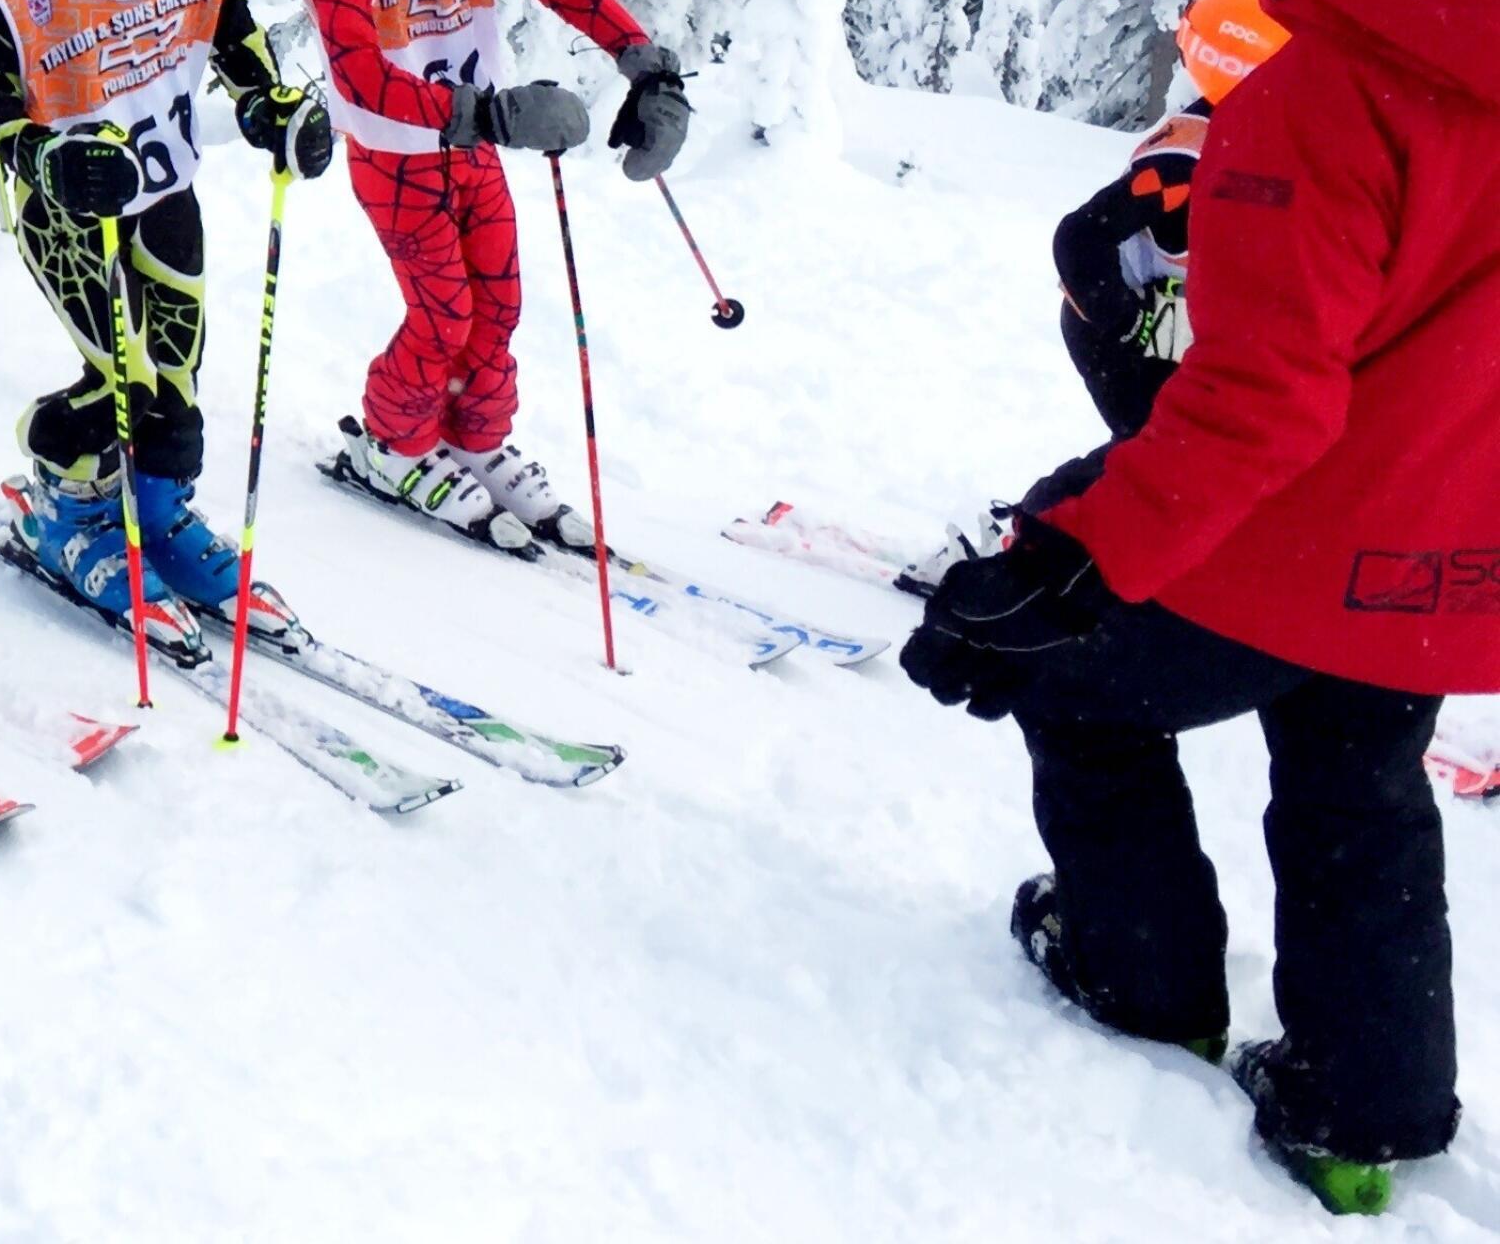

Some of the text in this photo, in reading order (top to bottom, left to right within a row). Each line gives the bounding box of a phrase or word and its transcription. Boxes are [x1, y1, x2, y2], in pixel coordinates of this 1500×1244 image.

[41, 26, 97, 73] TAYLOR
[97, 22, 111, 41] &
[111, 2, 155, 35] SONS
[1219, 20, 1260, 44] poc
[85, 148, 116, 157] LEKI
[128, 91, 199, 193] 61
